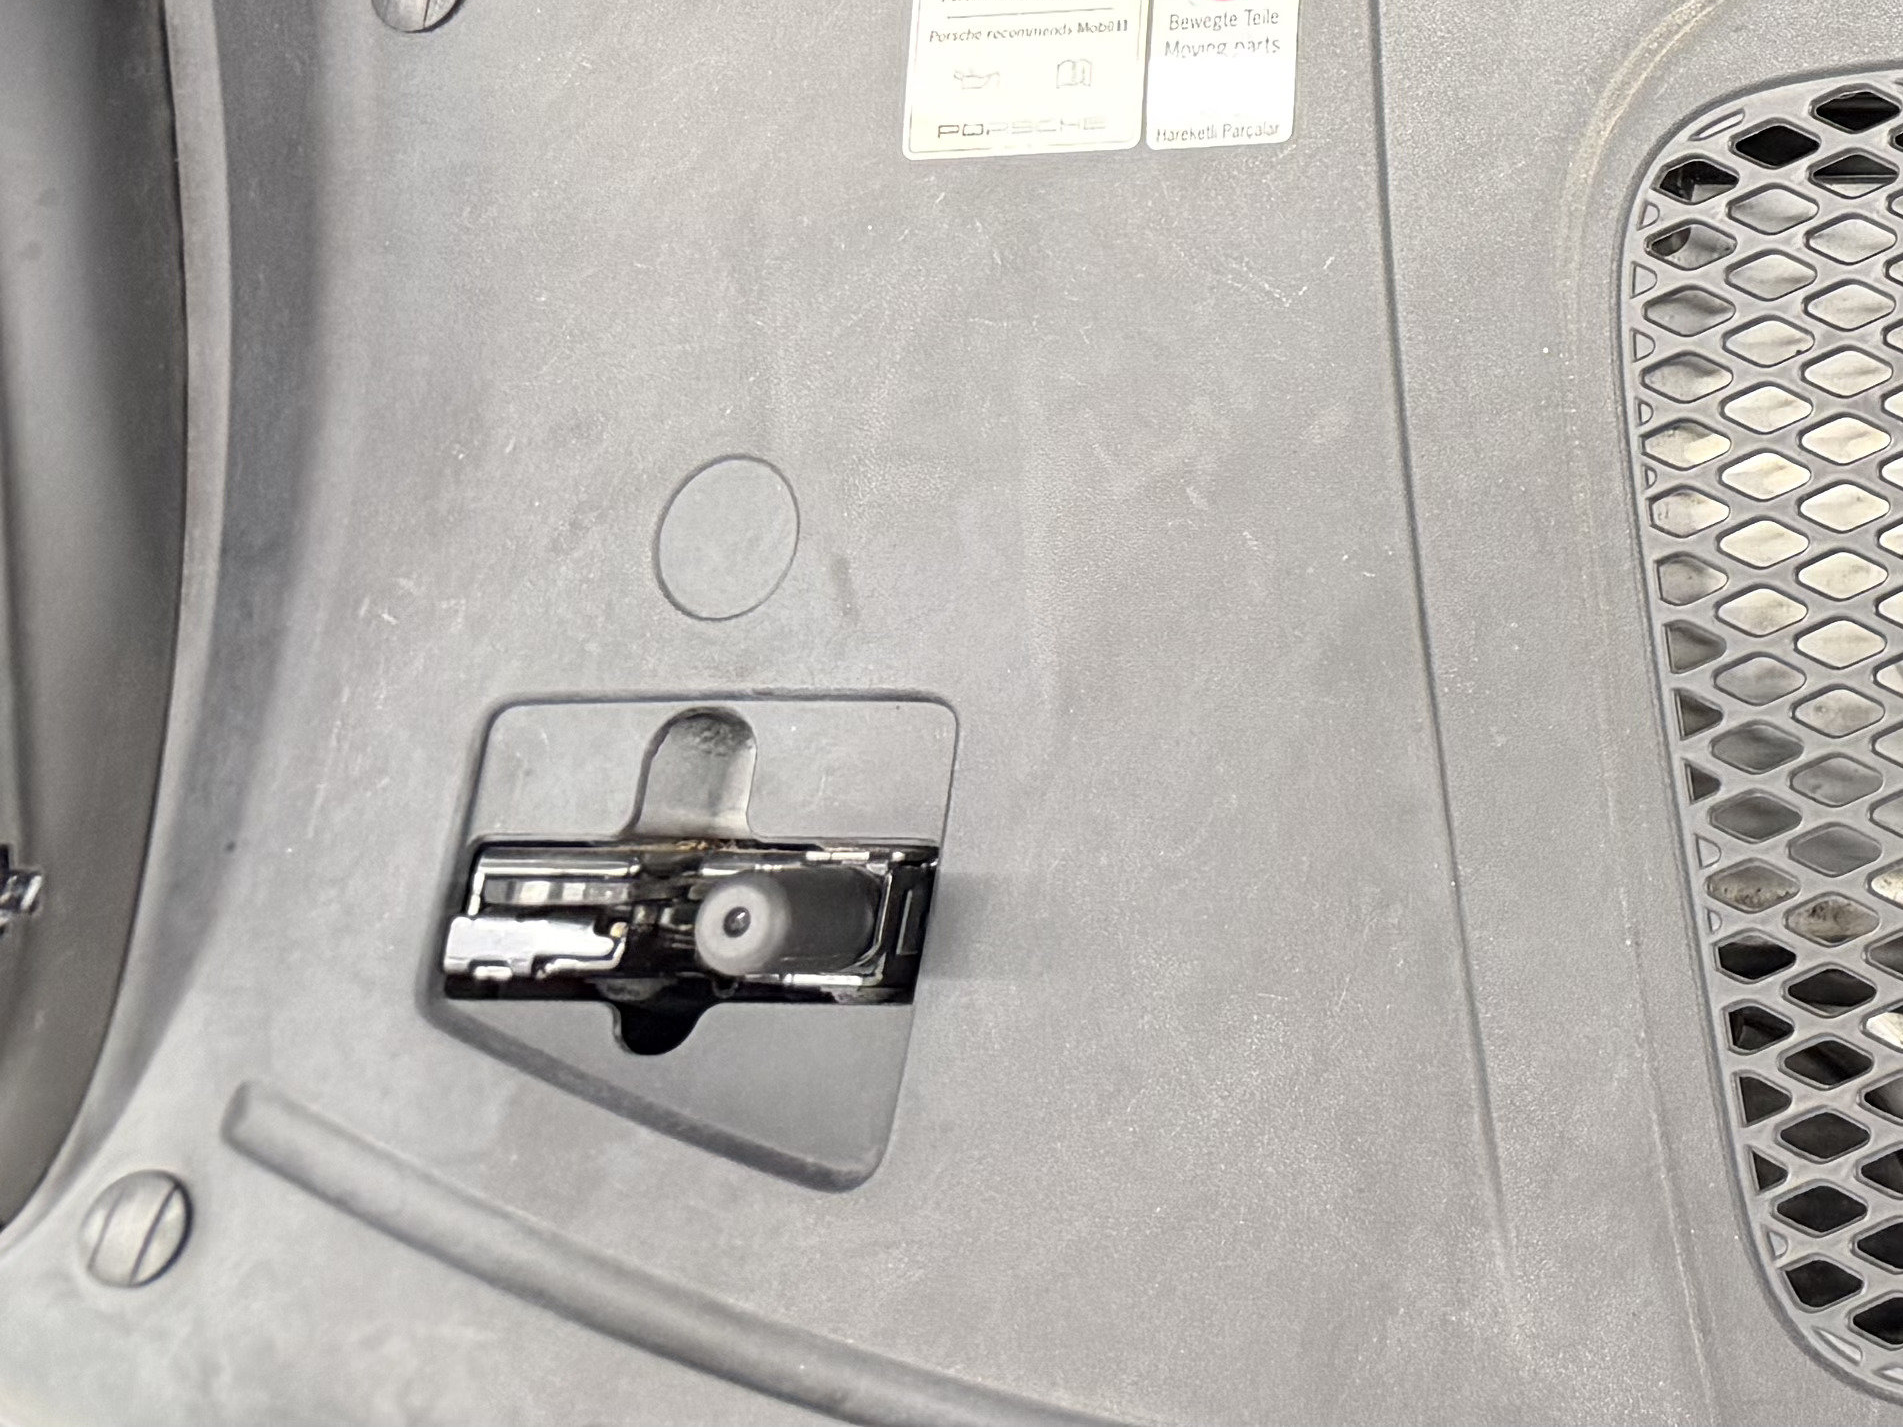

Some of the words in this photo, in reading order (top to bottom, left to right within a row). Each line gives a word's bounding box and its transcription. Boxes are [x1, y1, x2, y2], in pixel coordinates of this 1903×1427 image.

[1169, 12, 1238, 31] Bewegte
[1244, 9, 1279, 27] Teile
[929, 29, 981, 42] Porsche
